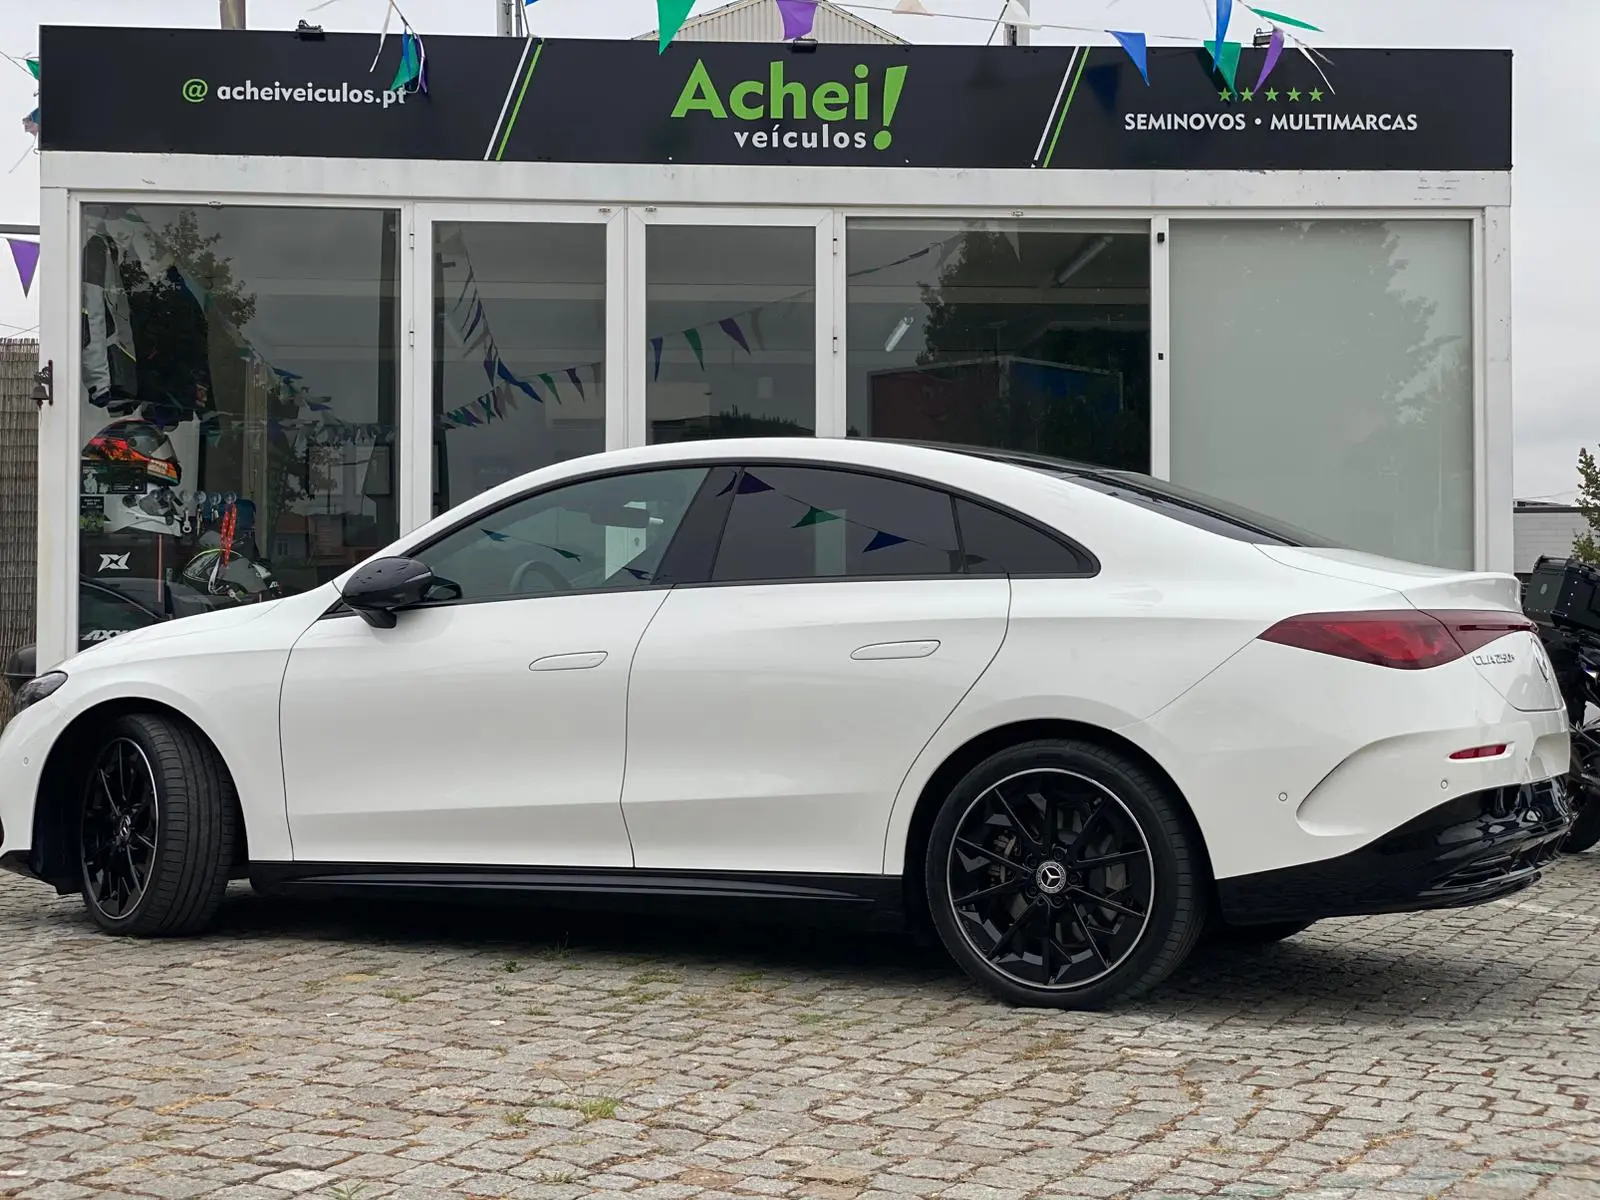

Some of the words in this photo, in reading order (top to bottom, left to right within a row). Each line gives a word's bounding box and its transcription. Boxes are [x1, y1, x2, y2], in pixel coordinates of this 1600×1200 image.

[182, 78, 209, 103] @
[216, 80, 407, 109] acheiveiculos.pt
[1124, 112, 1247, 131] SEMINOVOS
[1269, 113, 1419, 132] MULTIMARCAS
[733, 123, 868, 150] veículos
